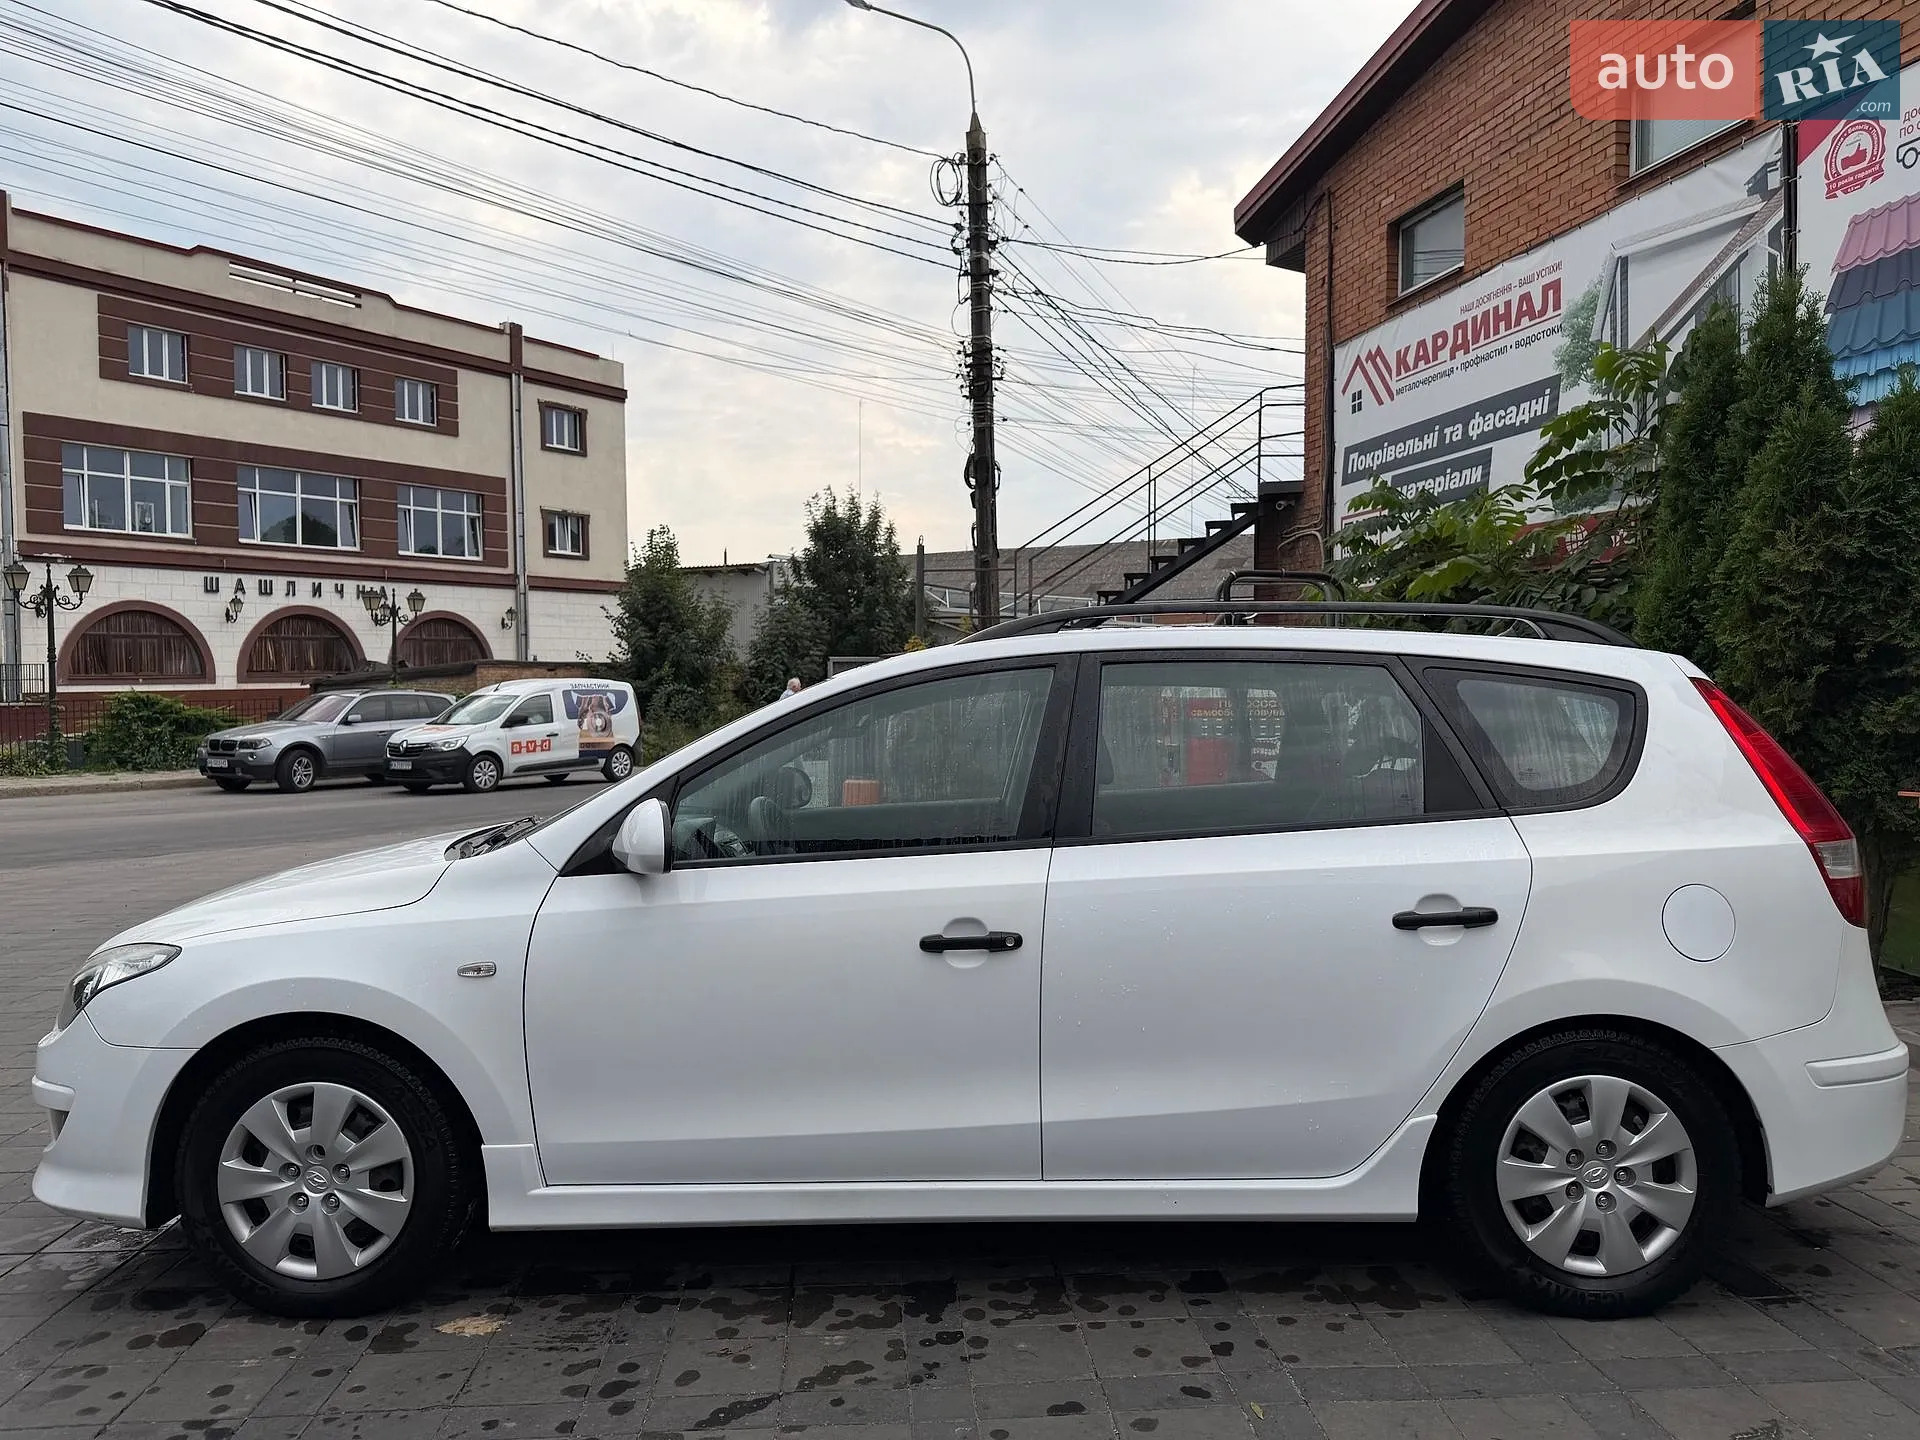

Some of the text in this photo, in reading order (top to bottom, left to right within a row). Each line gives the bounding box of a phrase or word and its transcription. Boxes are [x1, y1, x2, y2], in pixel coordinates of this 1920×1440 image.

[1899, 124, 1914, 138] ПО
[1396, 277, 1562, 377] КАРДИНАЛ
[1475, 283, 1513, 309] ДОСЯГНЕННЯ
[1396, 323, 1563, 396] металочерепиця профнастил водостоки
[1347, 389, 1550, 474] Покрівельні та фасадні
